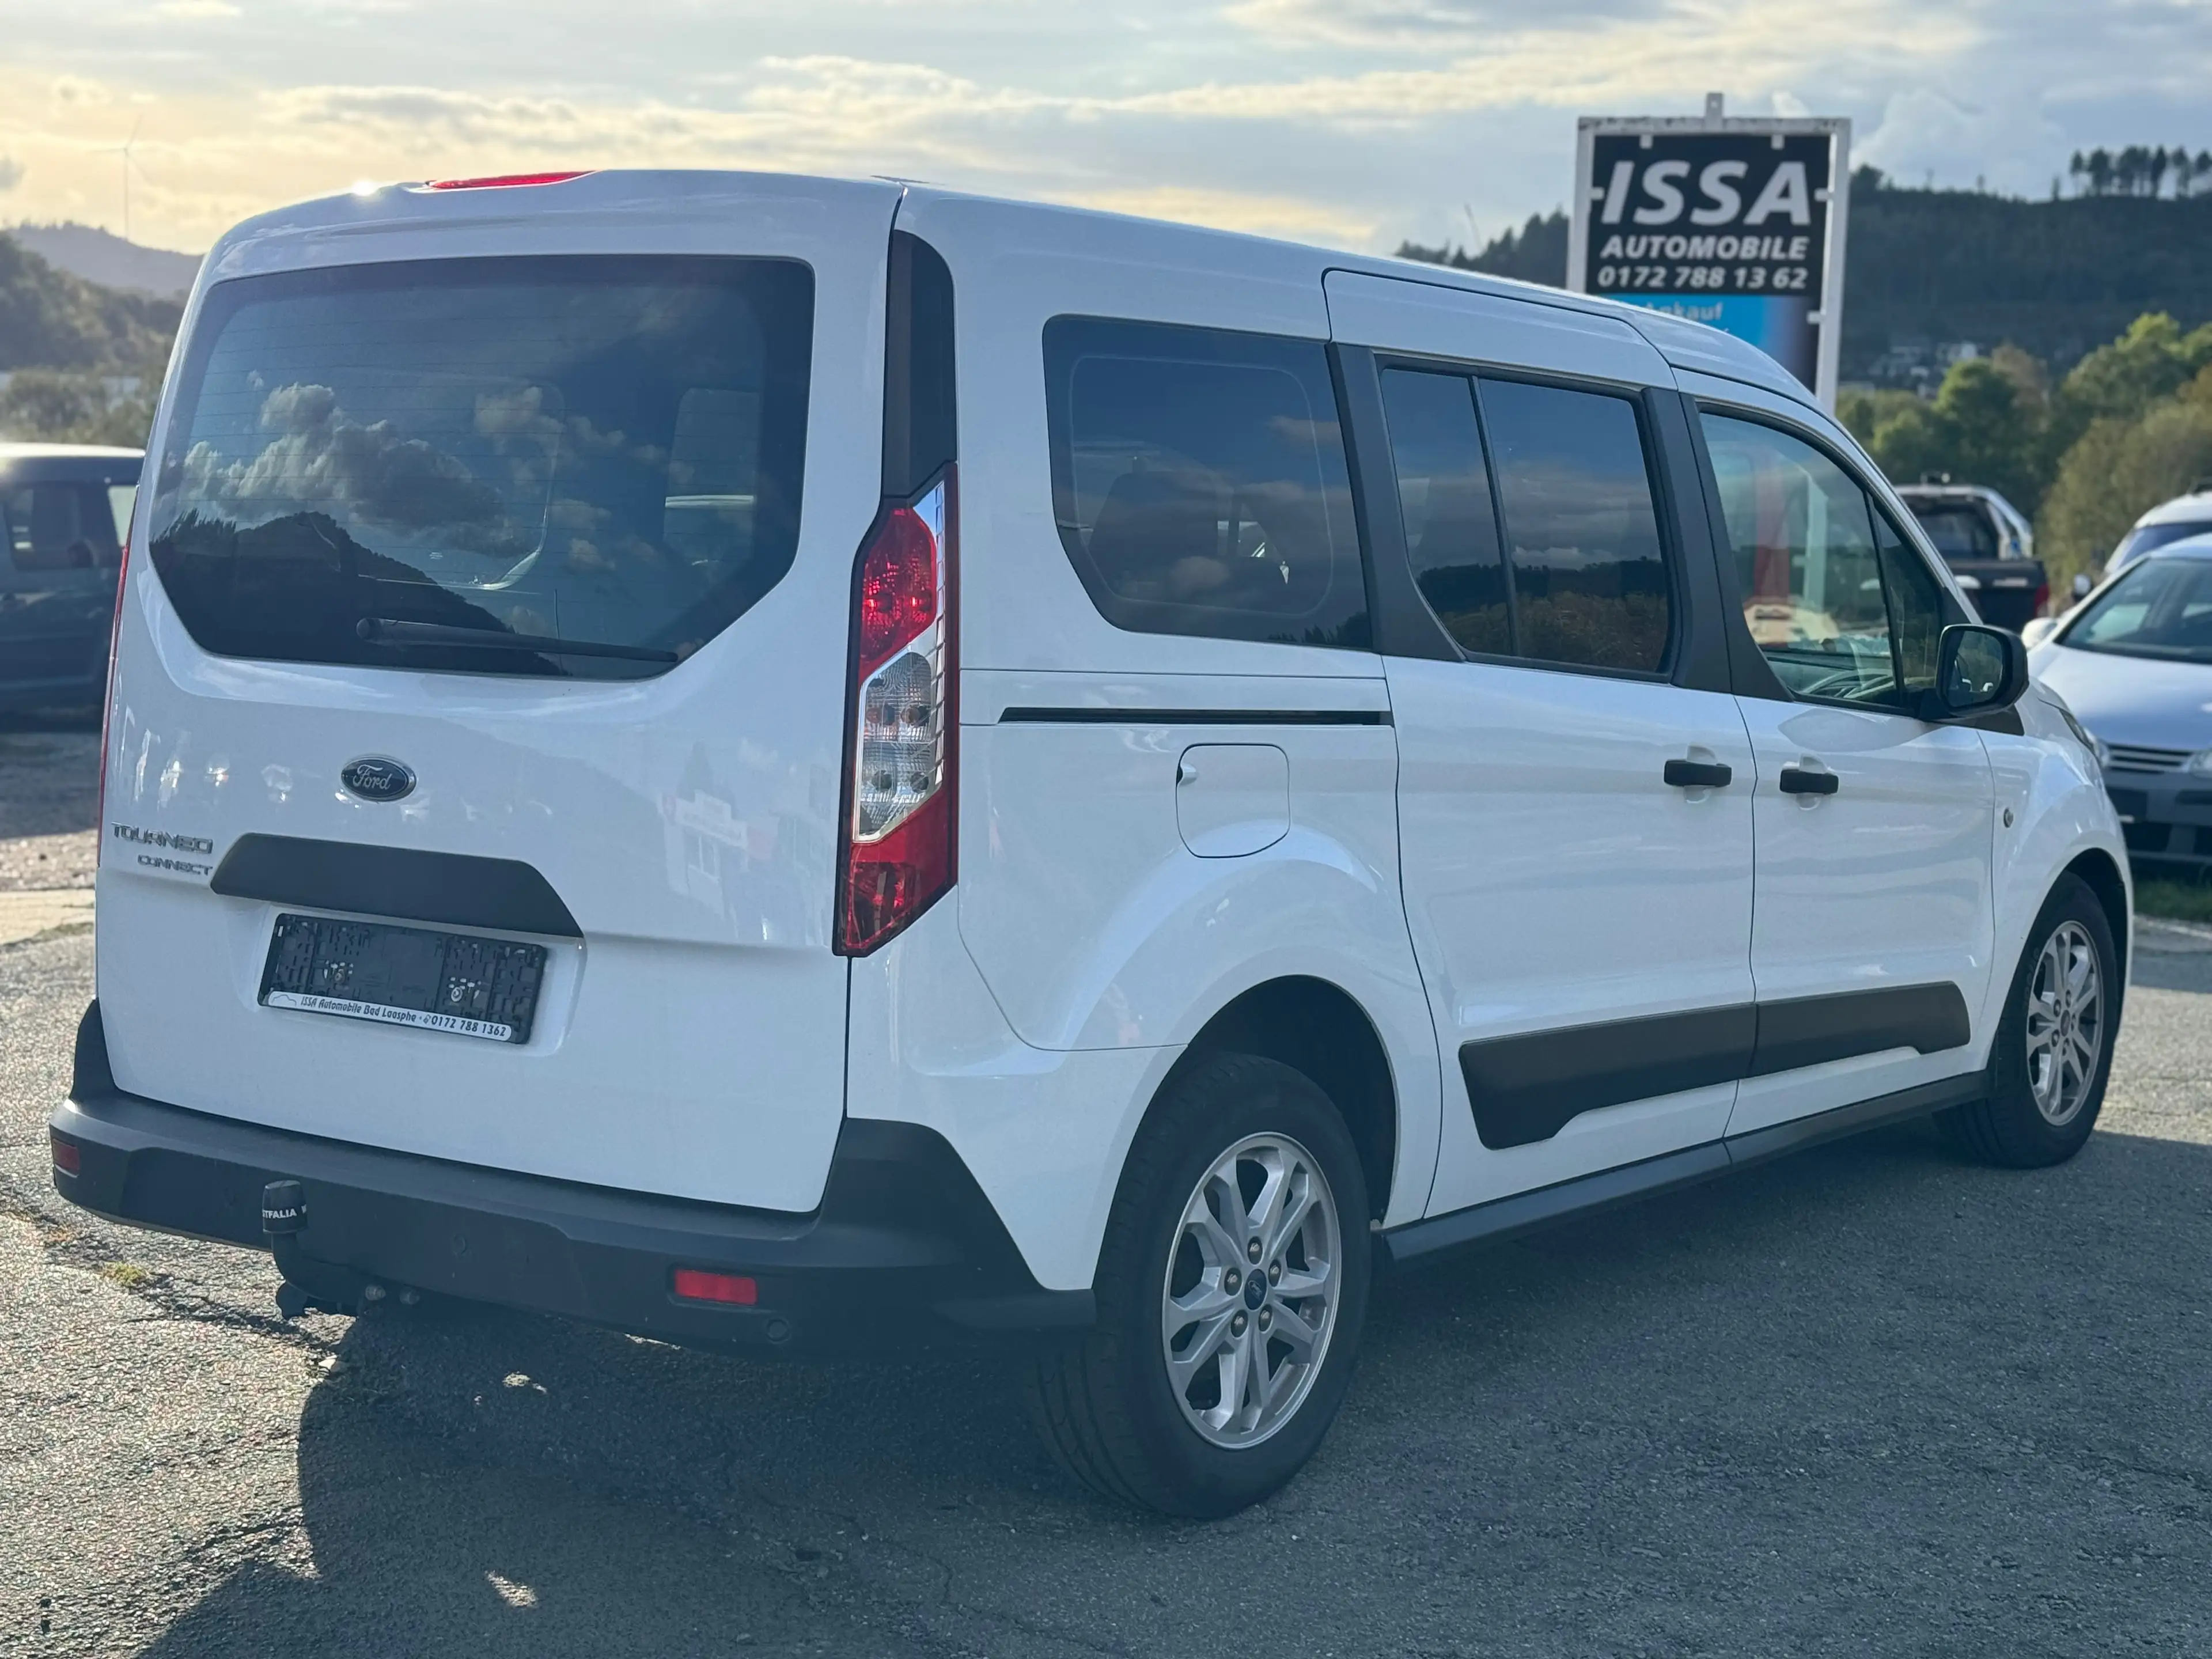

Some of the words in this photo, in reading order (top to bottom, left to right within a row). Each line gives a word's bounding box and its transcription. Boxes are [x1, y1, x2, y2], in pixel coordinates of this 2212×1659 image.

[1601, 160, 1811, 226] ISSA
[1599, 234, 1810, 260] AUTOMOBILE
[1597, 266, 1668, 288] 0172
[1673, 266, 1726, 289] 788
[1733, 266, 1767, 289] 13
[1772, 266, 1809, 290] 62
[353, 764, 392, 790] Ford
[111, 821, 213, 854] TOURNEO
[138, 854, 213, 876] CONNECT
[301, 996, 317, 1007] ISSA
[318, 999, 362, 1014] Automobile
[363, 1005, 381, 1016] Bad
[431, 1015, 457, 1029] 0172
[460, 1020, 479, 1032] 788
[482, 1024, 507, 1037] 1362
